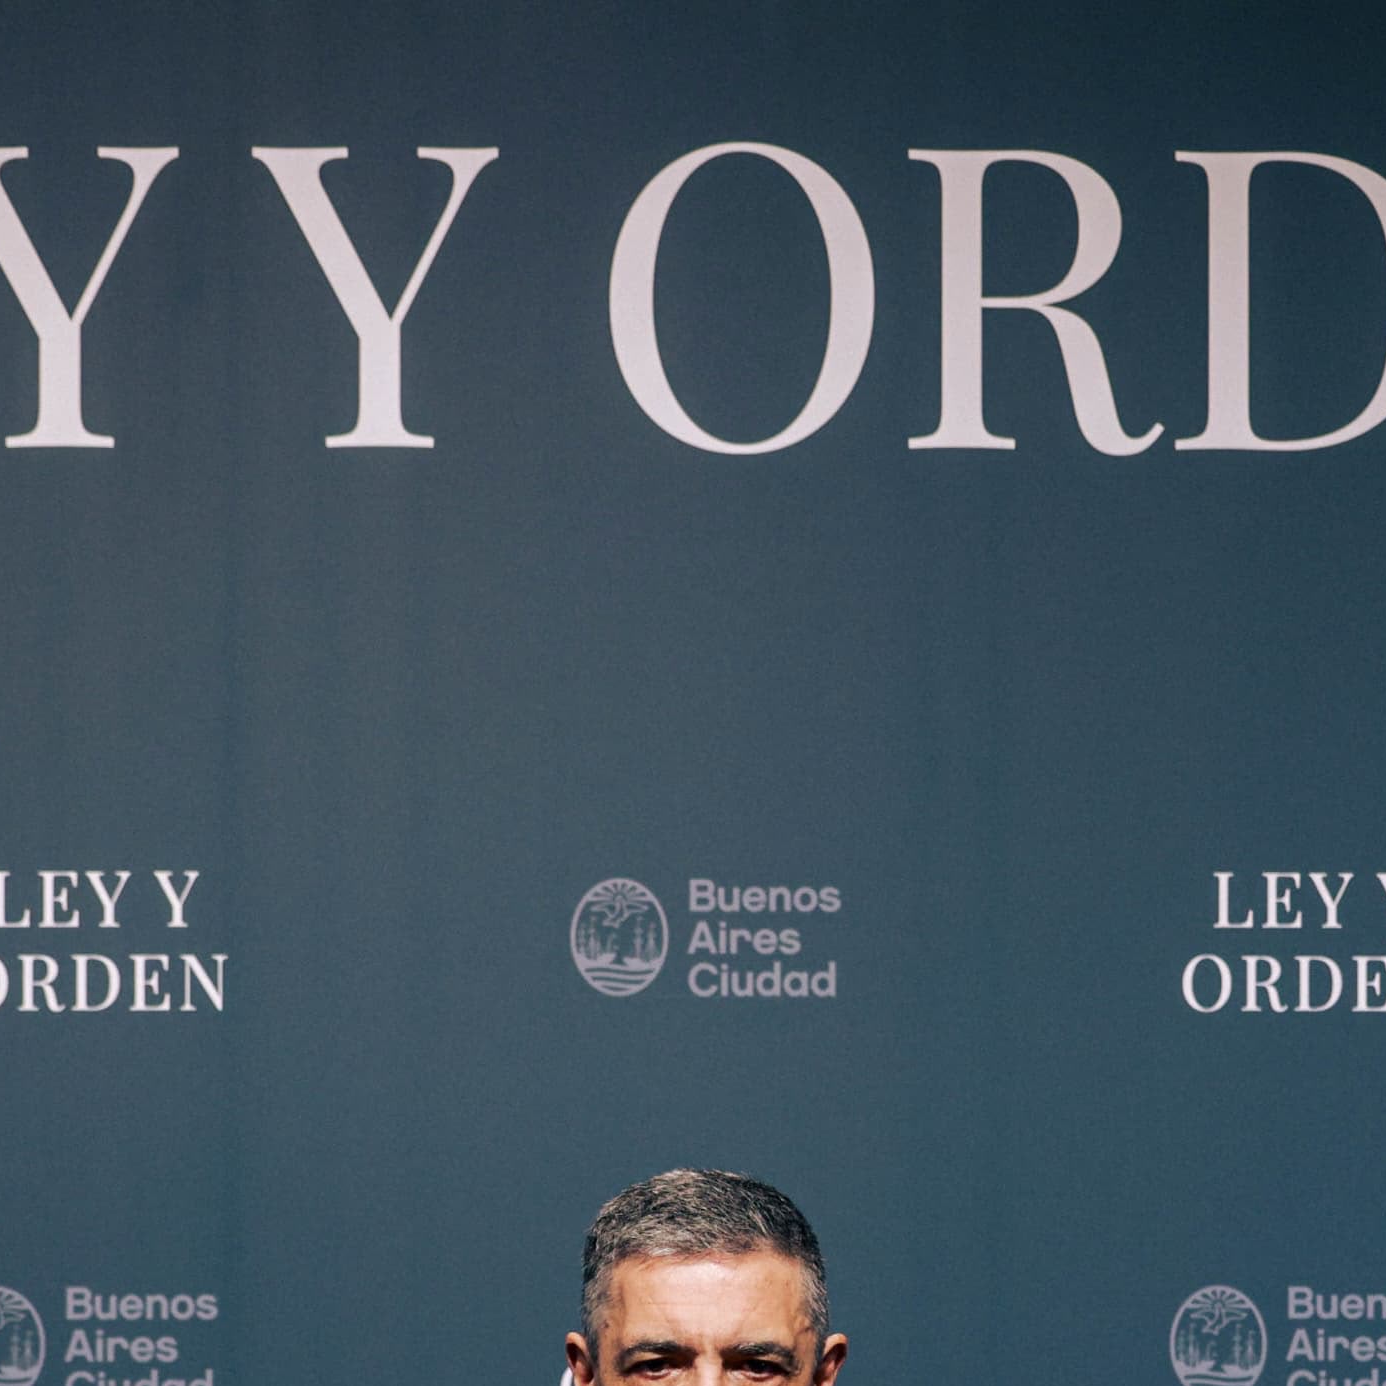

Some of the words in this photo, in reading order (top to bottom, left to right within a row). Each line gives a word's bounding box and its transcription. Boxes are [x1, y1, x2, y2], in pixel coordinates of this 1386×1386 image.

[250, 145, 500, 449] Y
[153, 869, 200, 928] Y
[689, 878, 841, 913] Buenos
[1213, 871, 1354, 929] LEY
[687, 920, 801, 954] Aires
[688, 961, 837, 998] Ciudad
[65, 1286, 218, 1321] Buenos
[64, 1329, 179, 1362] Aires
